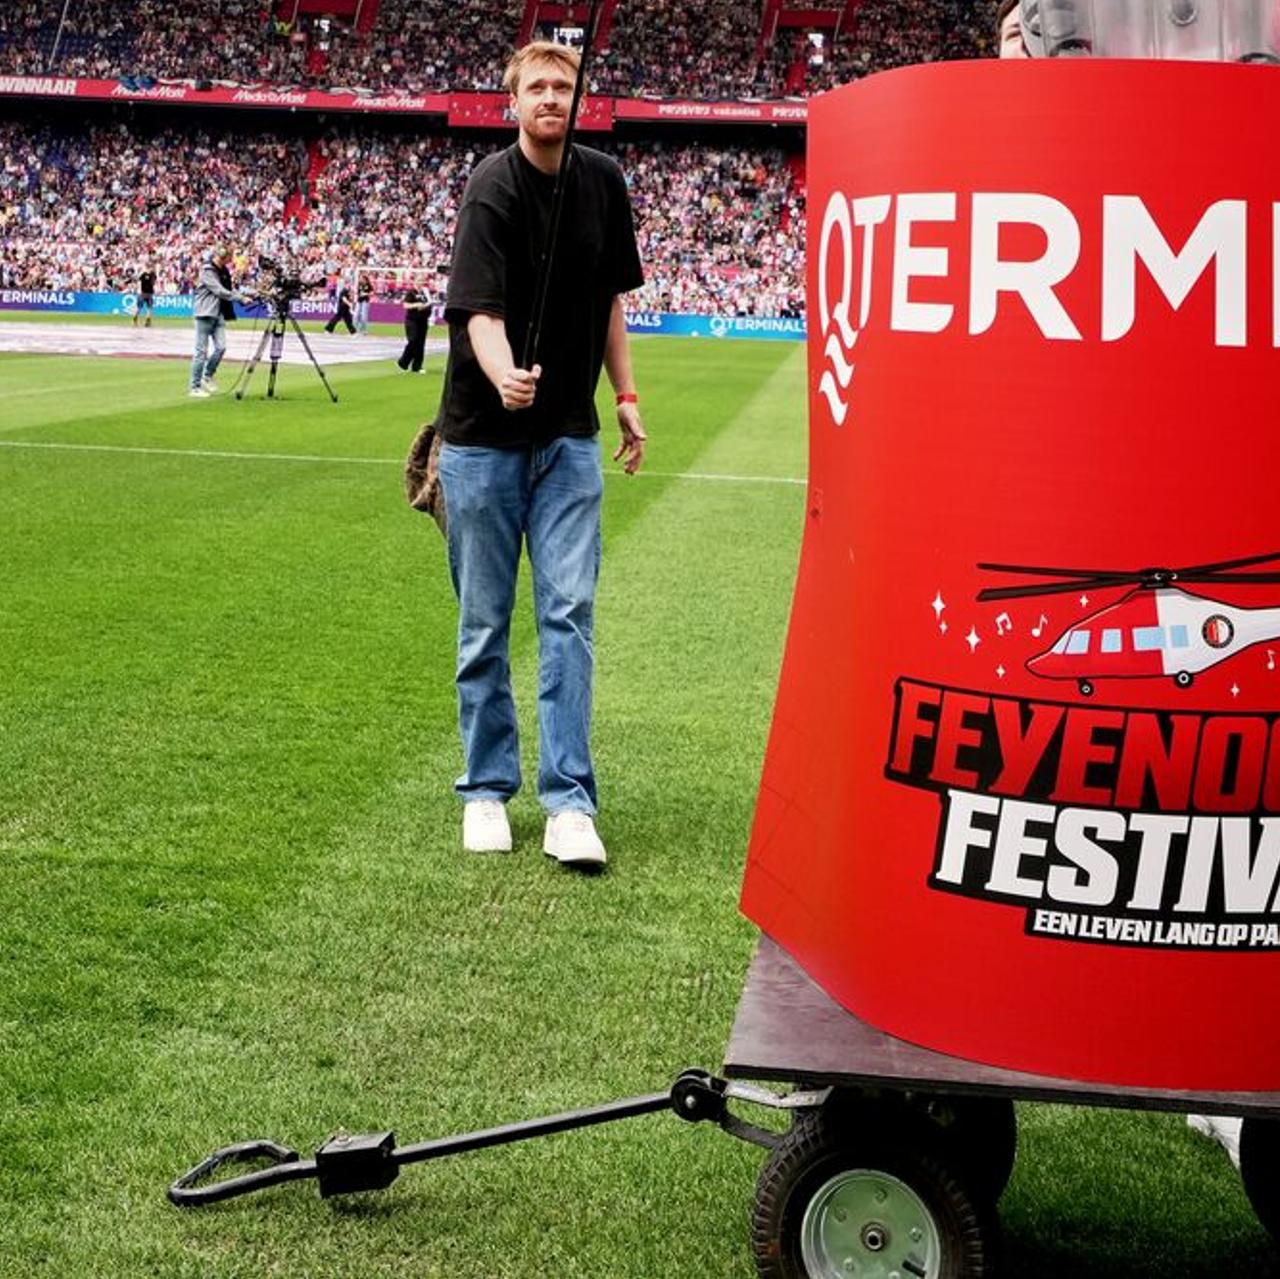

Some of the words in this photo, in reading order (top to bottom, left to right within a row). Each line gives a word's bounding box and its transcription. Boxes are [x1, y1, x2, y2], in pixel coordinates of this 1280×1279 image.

[1033, 908, 1078, 933] EEN
[1078, 914, 1158, 942] LEVEN
[1153, 921, 1217, 945] LANG
[1217, 923, 1248, 946] OP
